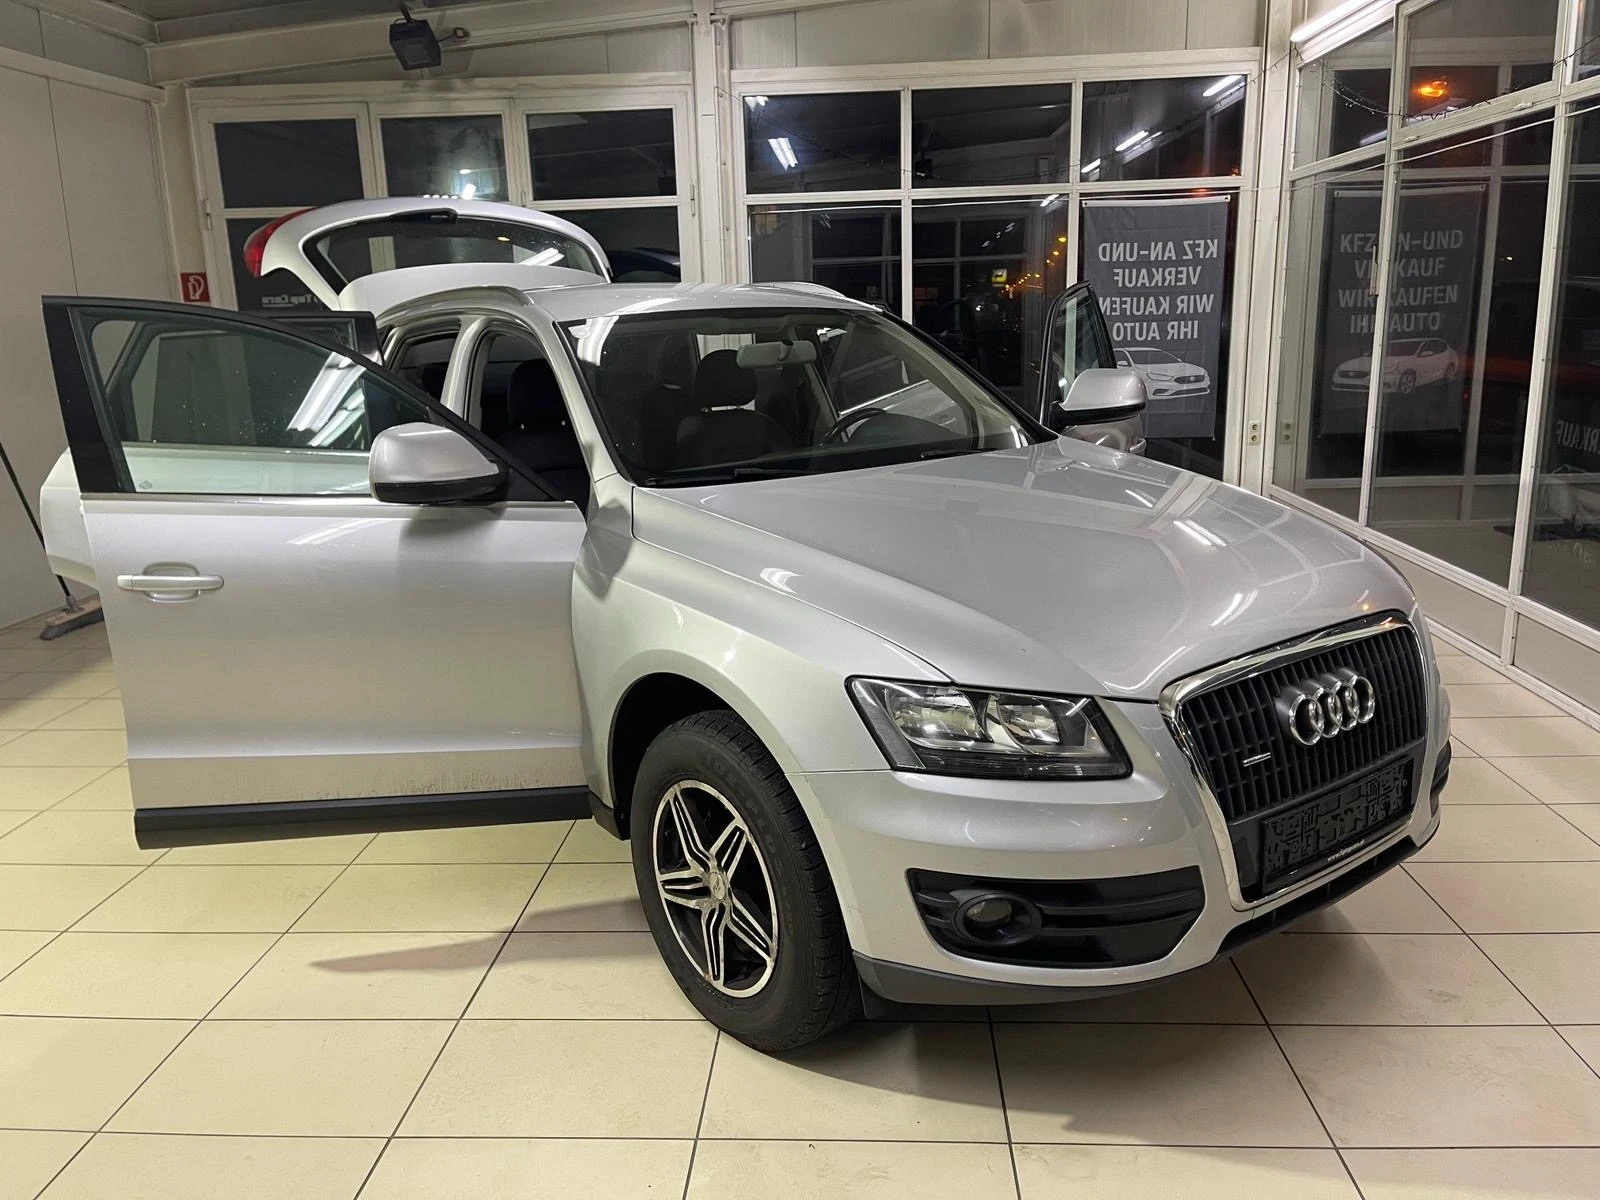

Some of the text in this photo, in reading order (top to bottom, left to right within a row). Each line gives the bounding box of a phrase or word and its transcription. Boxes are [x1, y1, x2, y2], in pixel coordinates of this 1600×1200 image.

[1340, 229, 1463, 253] KFZ N-UND
[1354, 257, 1446, 279] VKAUF
[1390, 284, 1458, 307] AUFEN
[1350, 312, 1441, 334] IH AUTO
